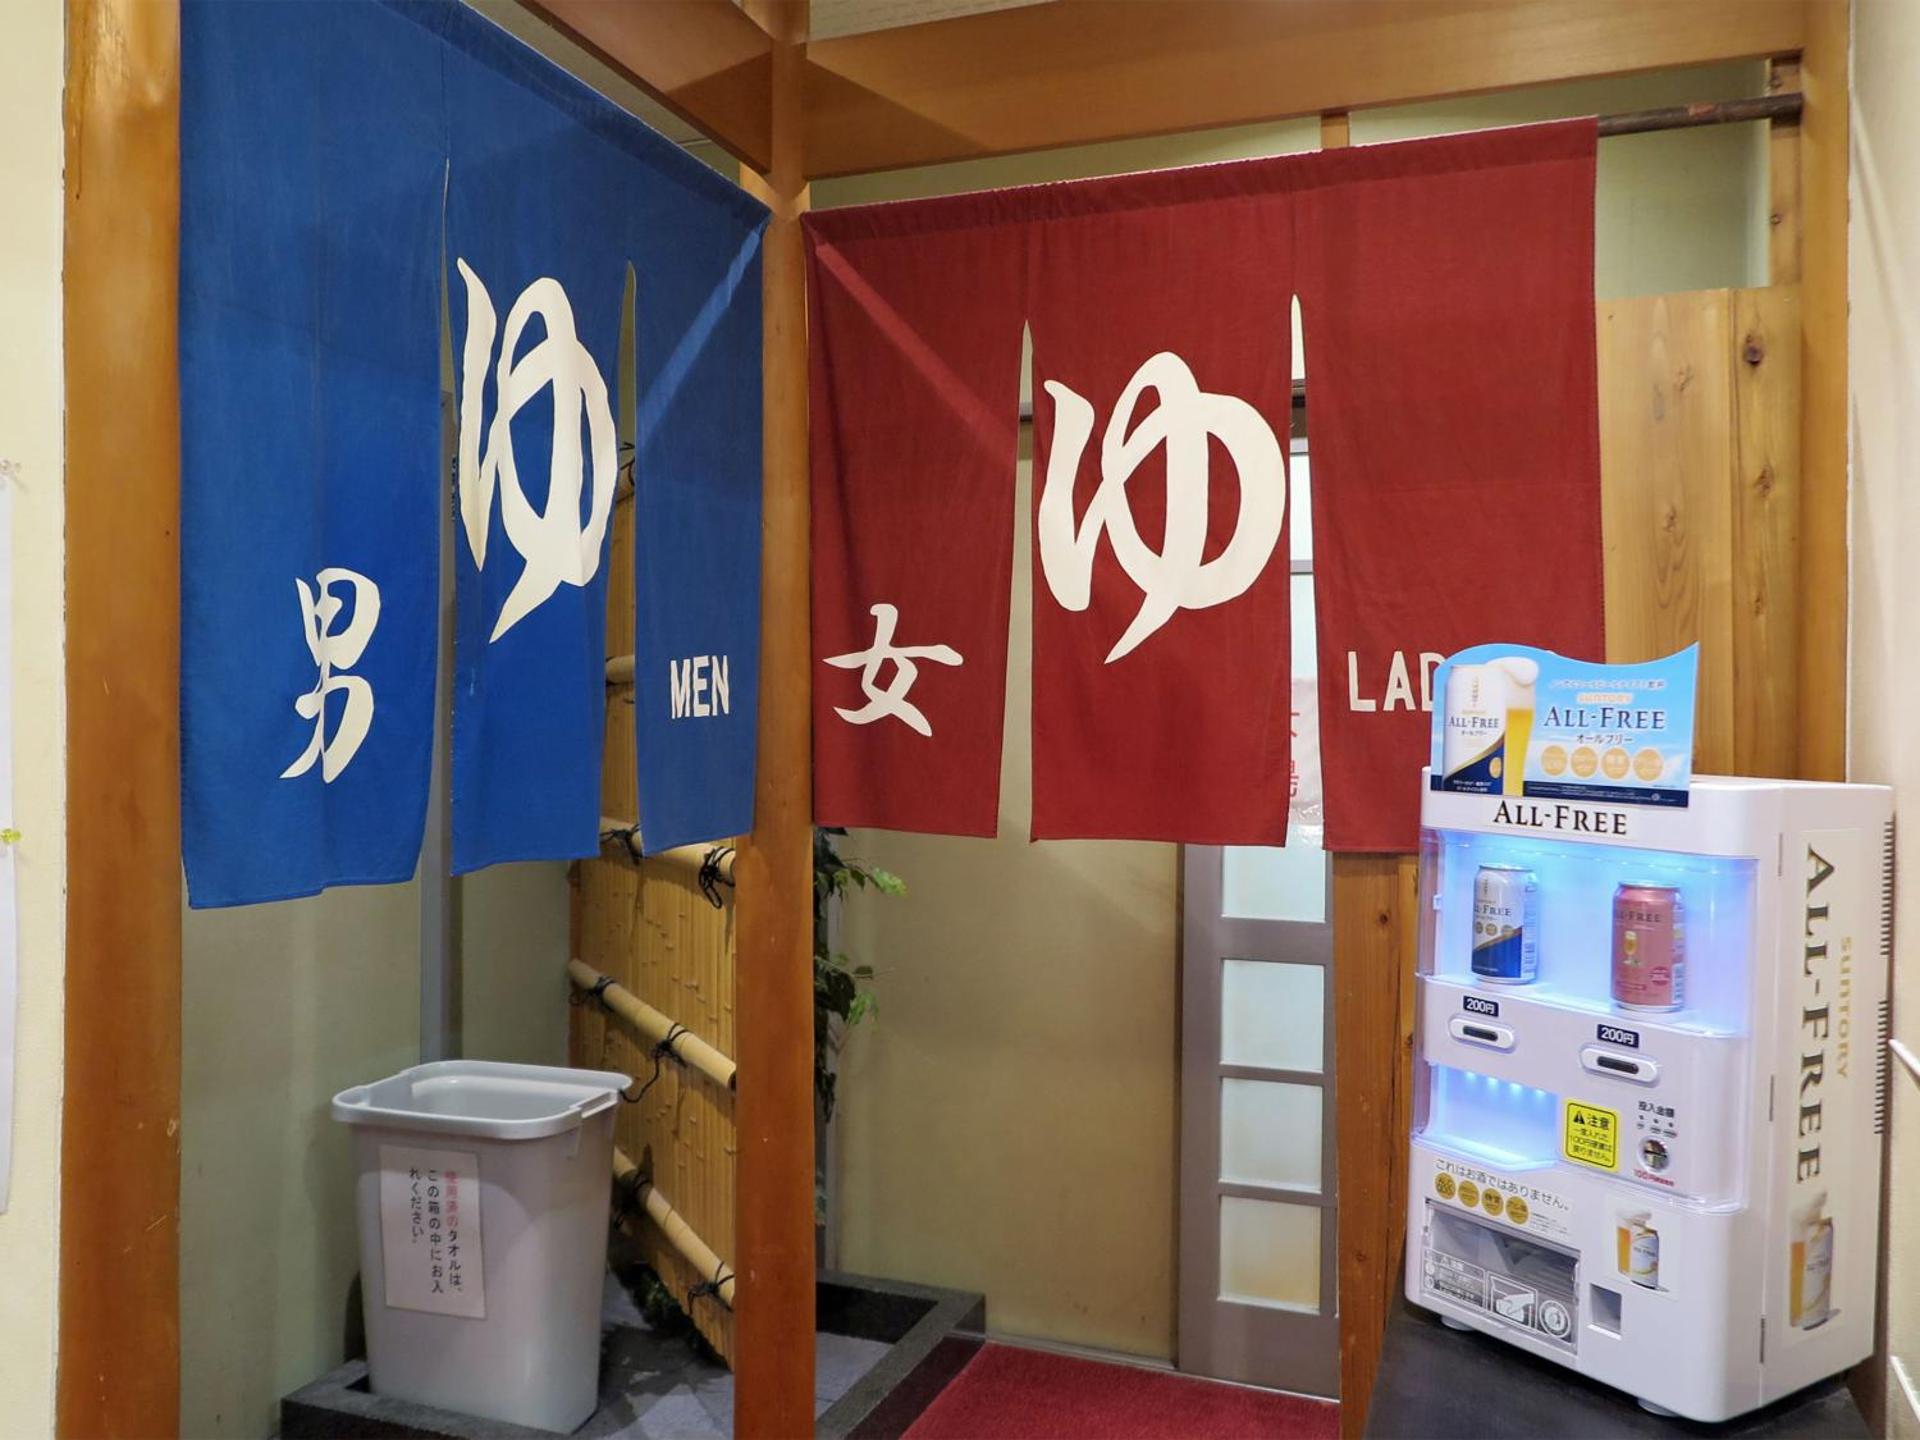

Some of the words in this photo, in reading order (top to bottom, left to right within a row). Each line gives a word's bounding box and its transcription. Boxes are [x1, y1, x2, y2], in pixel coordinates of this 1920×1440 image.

[457, 257, 618, 643] ゆ
[1039, 351, 1286, 665] ゆ
[280, 567, 381, 783] 男
[670, 655, 730, 719] MEN
[822, 603, 964, 737] 女
[1544, 706, 1665, 729] ALL-FREE
[1577, 733, 1633, 744] オールフリー
[1493, 800, 1628, 836] ALL-FREE
[1466, 998, 1495, 1015] 200円
[1600, 1027, 1635, 1045] 200円
[1797, 842, 1835, 1185] ALL-FREE
[409, 1167, 425, 1244] れください。
[1435, 1159, 1569, 1211] これはお酒ではありません。
[427, 1169, 444, 1294] この箱の中にお入
